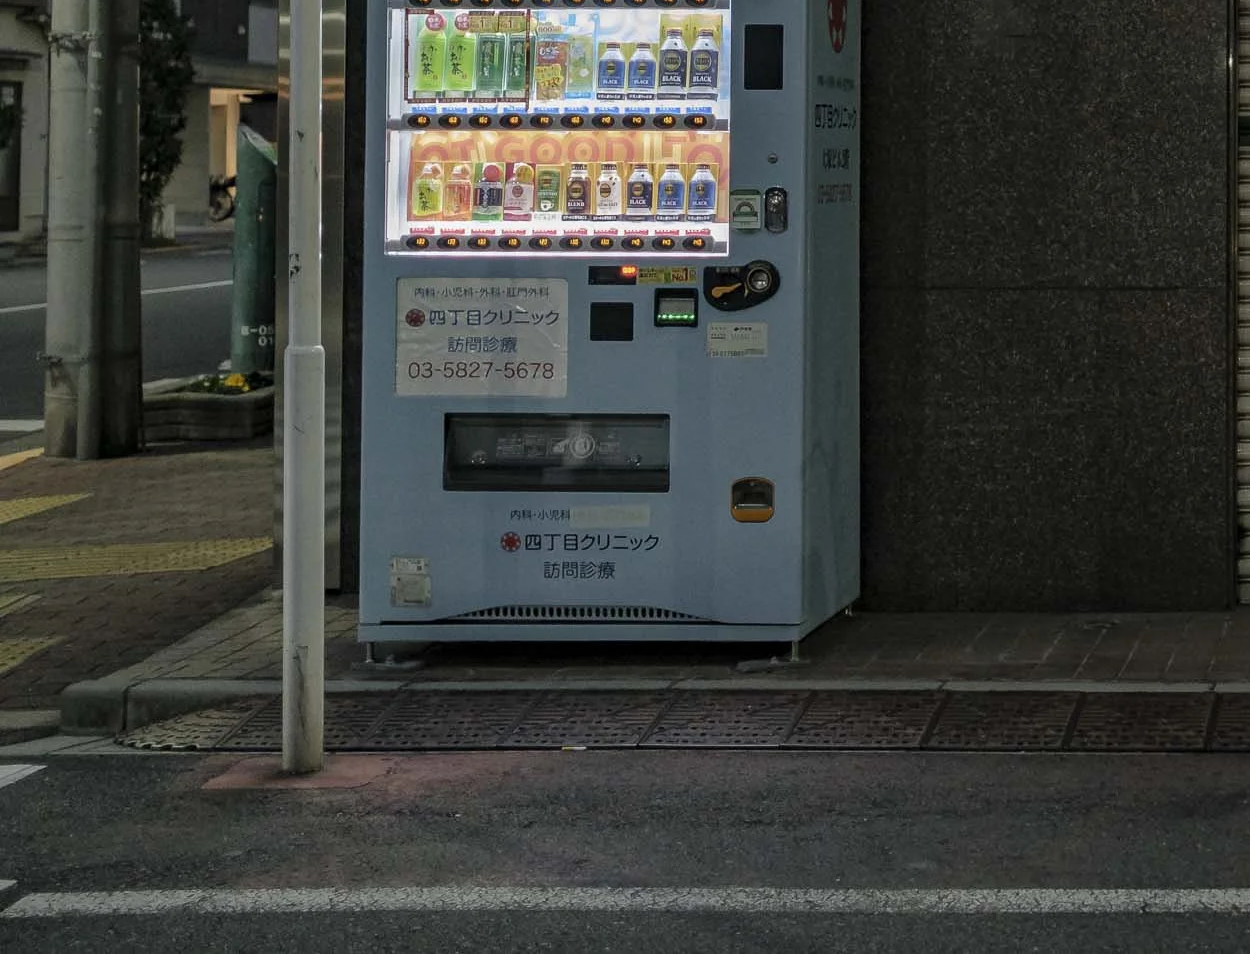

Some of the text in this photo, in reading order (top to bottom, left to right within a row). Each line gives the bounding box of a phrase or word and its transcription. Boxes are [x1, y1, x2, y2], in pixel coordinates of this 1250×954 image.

[662, 75, 682, 83] BLACK
[692, 75, 712, 83] BLACK
[429, 309, 560, 326] 四丁目クリニック
[447, 336, 518, 354] 訪問診療
[408, 361, 555, 379] 03-5827-5678
[525, 533, 659, 551] 四丁目クリニック
[544, 561, 617, 580] 訪問診療
